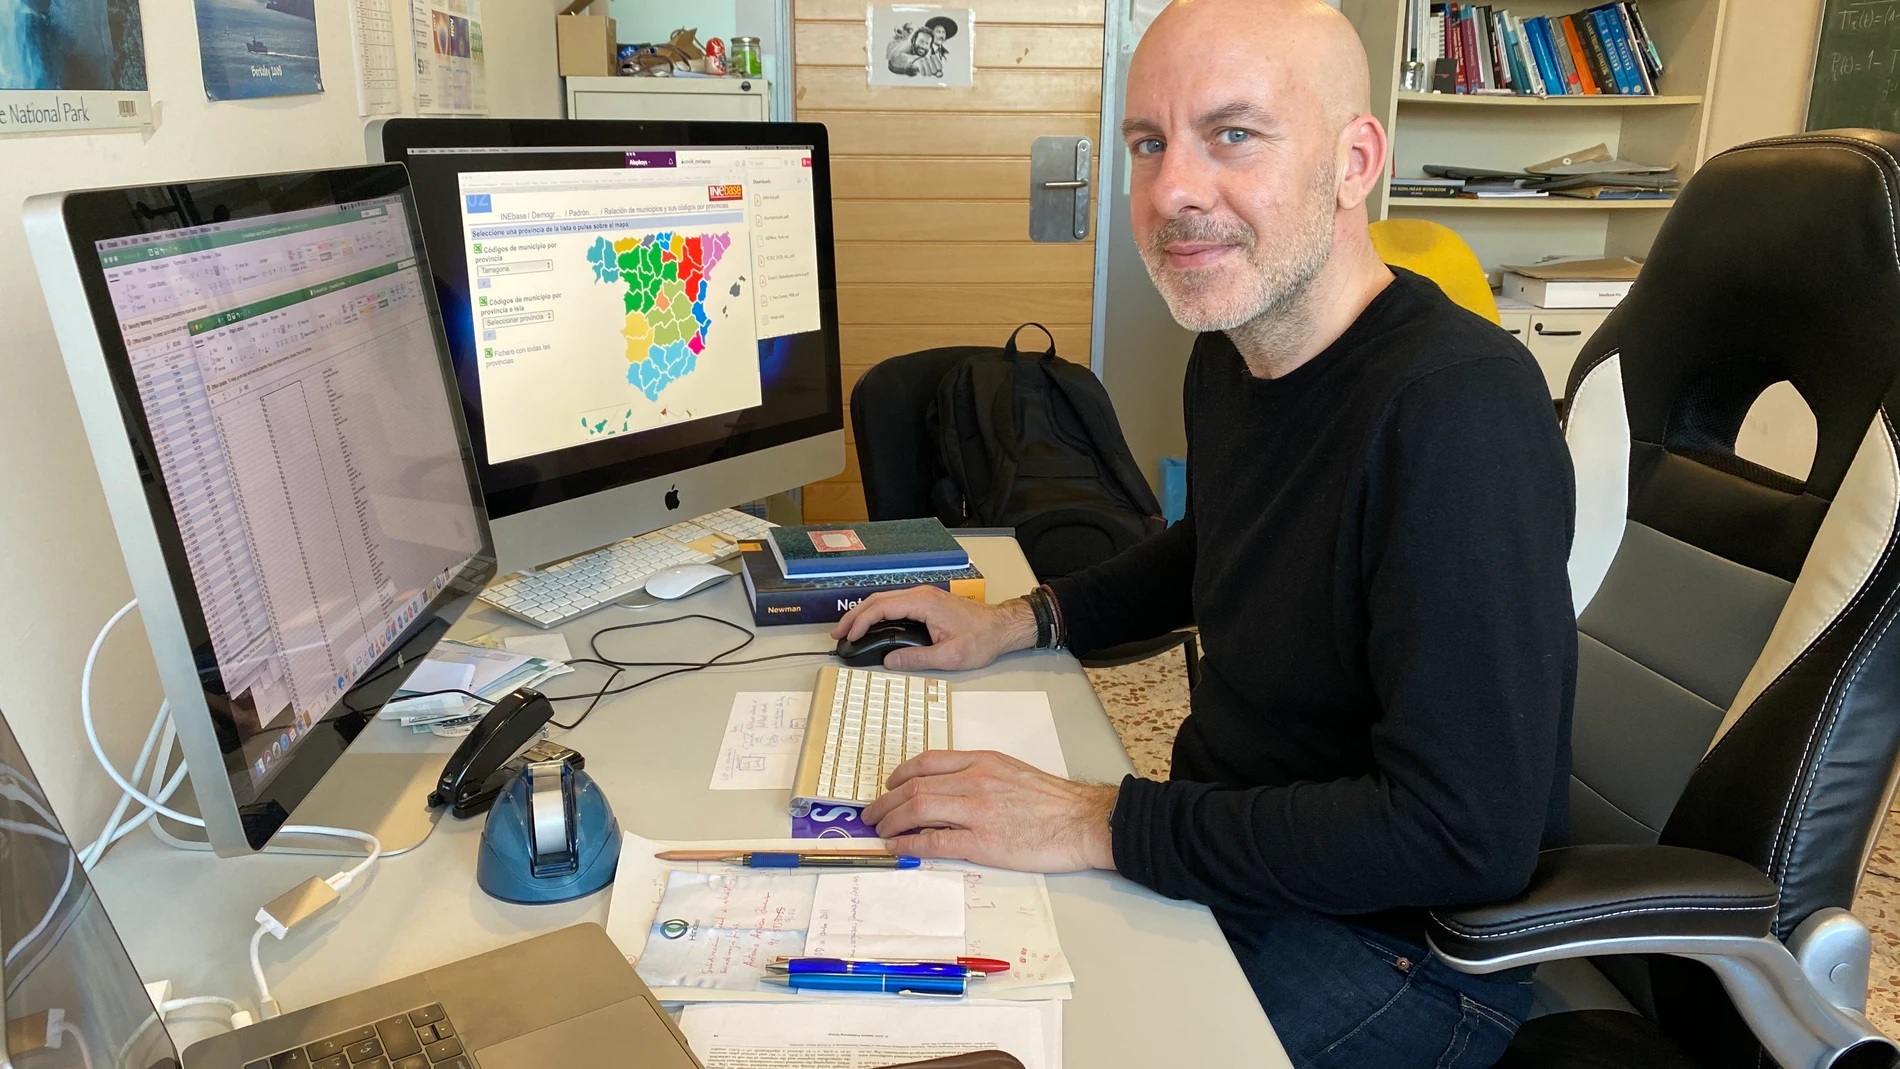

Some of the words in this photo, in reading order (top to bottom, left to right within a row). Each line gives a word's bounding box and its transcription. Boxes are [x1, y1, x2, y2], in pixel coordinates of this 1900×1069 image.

[1606, 39, 1620, 71] CALCULUS
[1618, 39, 1631, 70] CALCULUS
[9, 96, 61, 124] National
[63, 96, 90, 122] Park
[604, 207, 627, 215] Relación
[636, 205, 663, 214] municipios
[678, 204, 696, 212] códigos
[472, 229, 504, 237] Seleccione
[519, 226, 544, 236] provincia
[578, 224, 592, 232] pulse
[518, 243, 546, 251] municipio
[475, 255, 503, 264] provincia
[489, 298, 513, 306] Códigos
[481, 307, 508, 317] provincia
[487, 317, 519, 326] Seleccionar
[520, 314, 543, 322] provincia
[494, 348, 515, 357] Fichero
[486, 358, 513, 368] provincias
[768, 606, 801, 614] Newman
